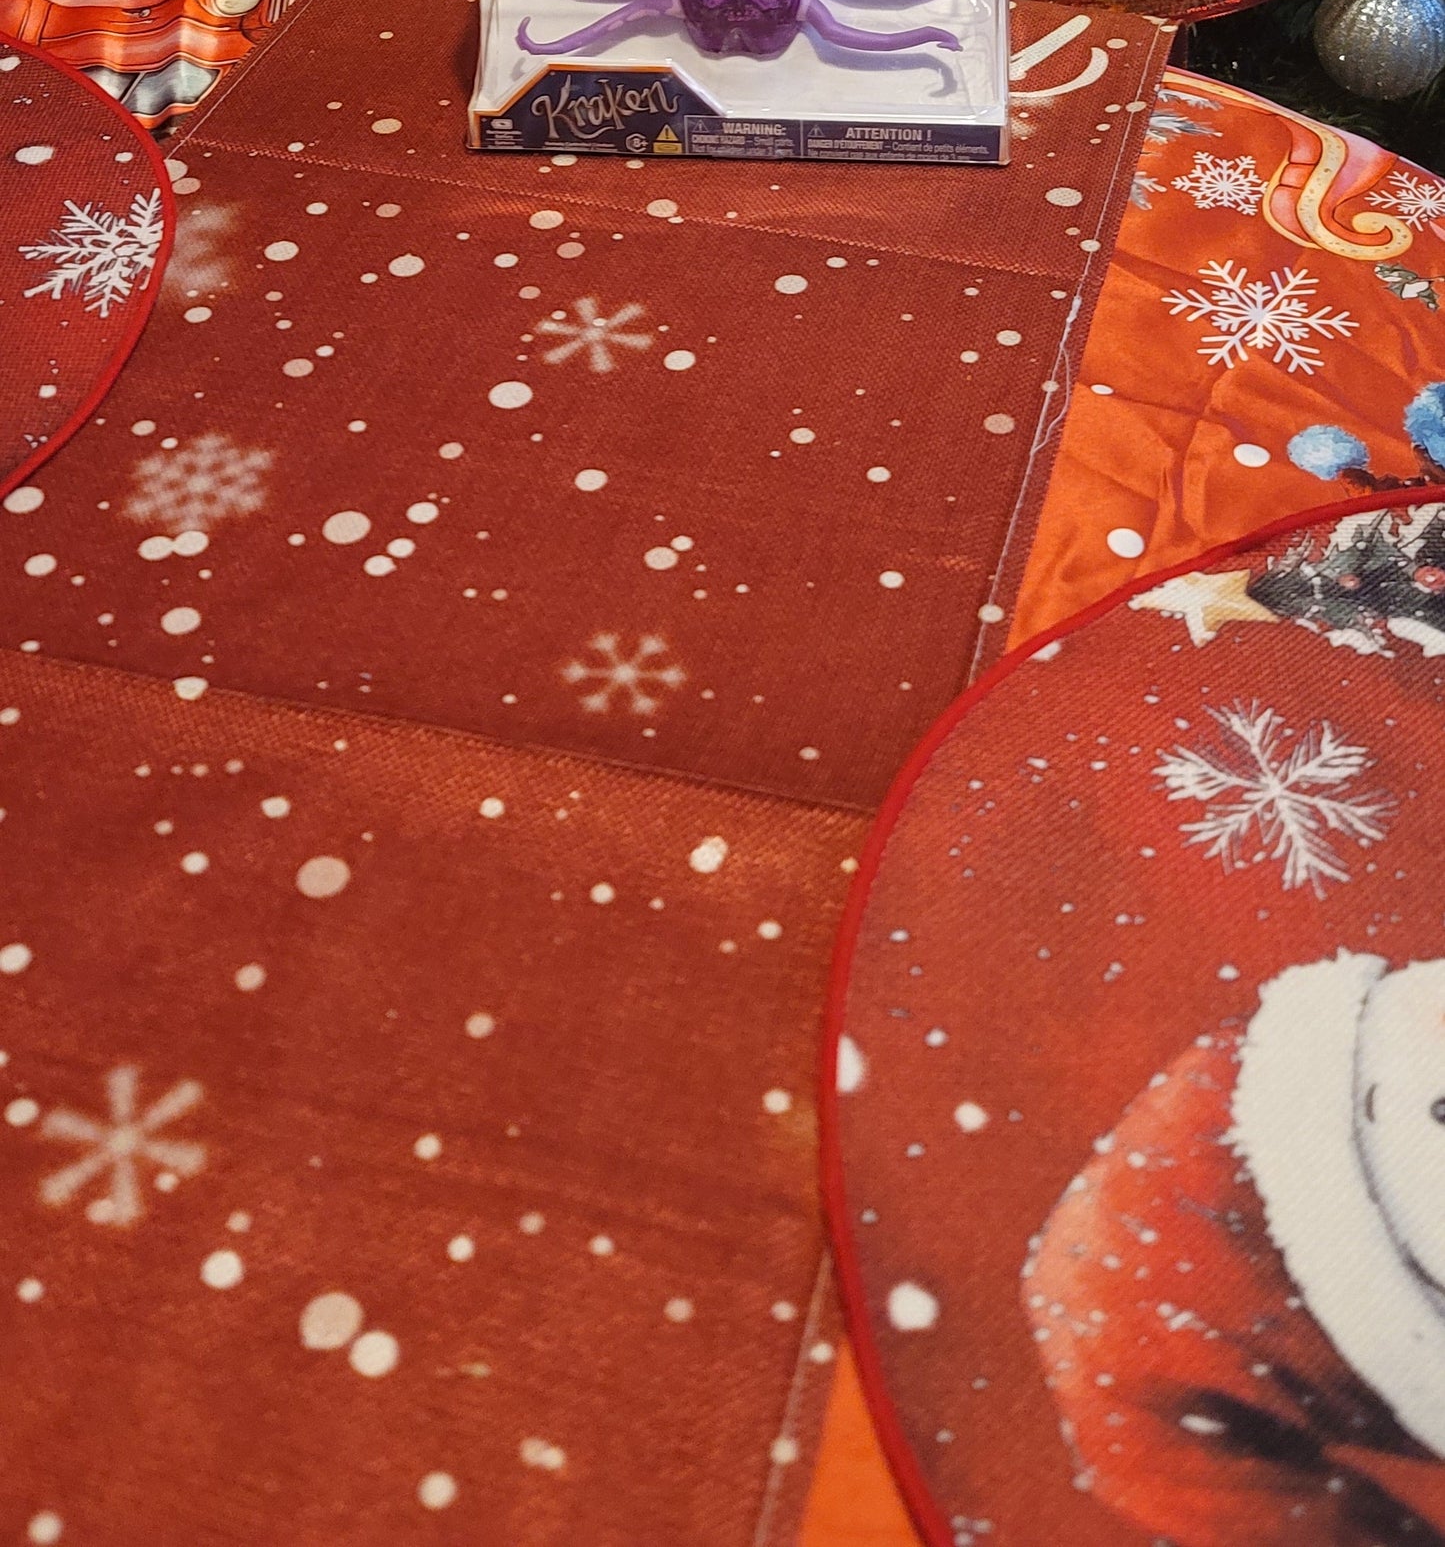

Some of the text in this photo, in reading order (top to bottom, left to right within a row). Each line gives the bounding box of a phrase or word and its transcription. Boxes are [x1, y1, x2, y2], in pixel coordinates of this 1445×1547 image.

[531, 74, 681, 139] Kraken
[722, 122, 787, 136] WARNING:
[845, 127, 923, 141] ATTENTION
[754, 136, 774, 146] Small
[892, 141, 922, 152] Contient
[923, 143, 933, 152] de
[934, 143, 954, 154] petits
